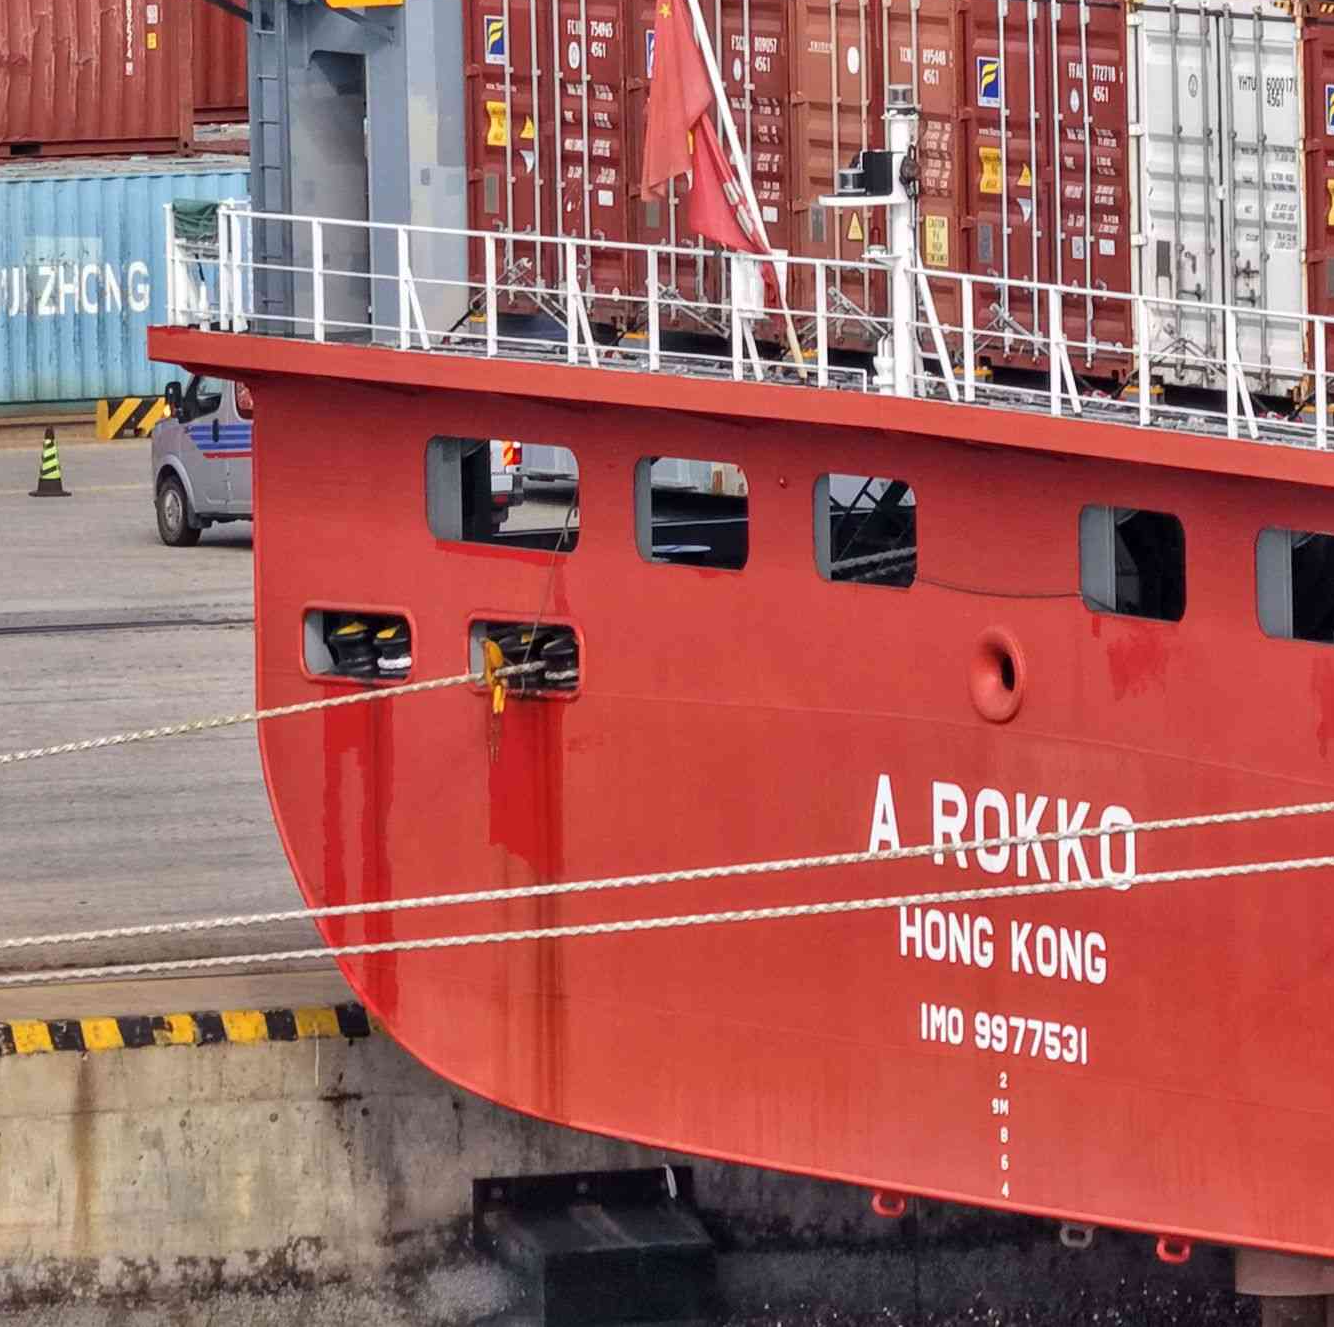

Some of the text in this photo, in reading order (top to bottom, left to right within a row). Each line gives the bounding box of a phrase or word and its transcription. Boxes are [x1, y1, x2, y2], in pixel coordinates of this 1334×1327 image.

[38, 261, 150, 317] ZHONG
[868, 773, 1137, 891] A ROKKO
[899, 905, 1107, 985] HONG KONG
[920, 1002, 1088, 1065] IMO 9977531
[999, 1072, 1008, 1089] 2
[991, 1098, 1009, 1115] 9M
[1000, 1154, 1009, 1170] 6
[1001, 1182, 1009, 1199] 4
